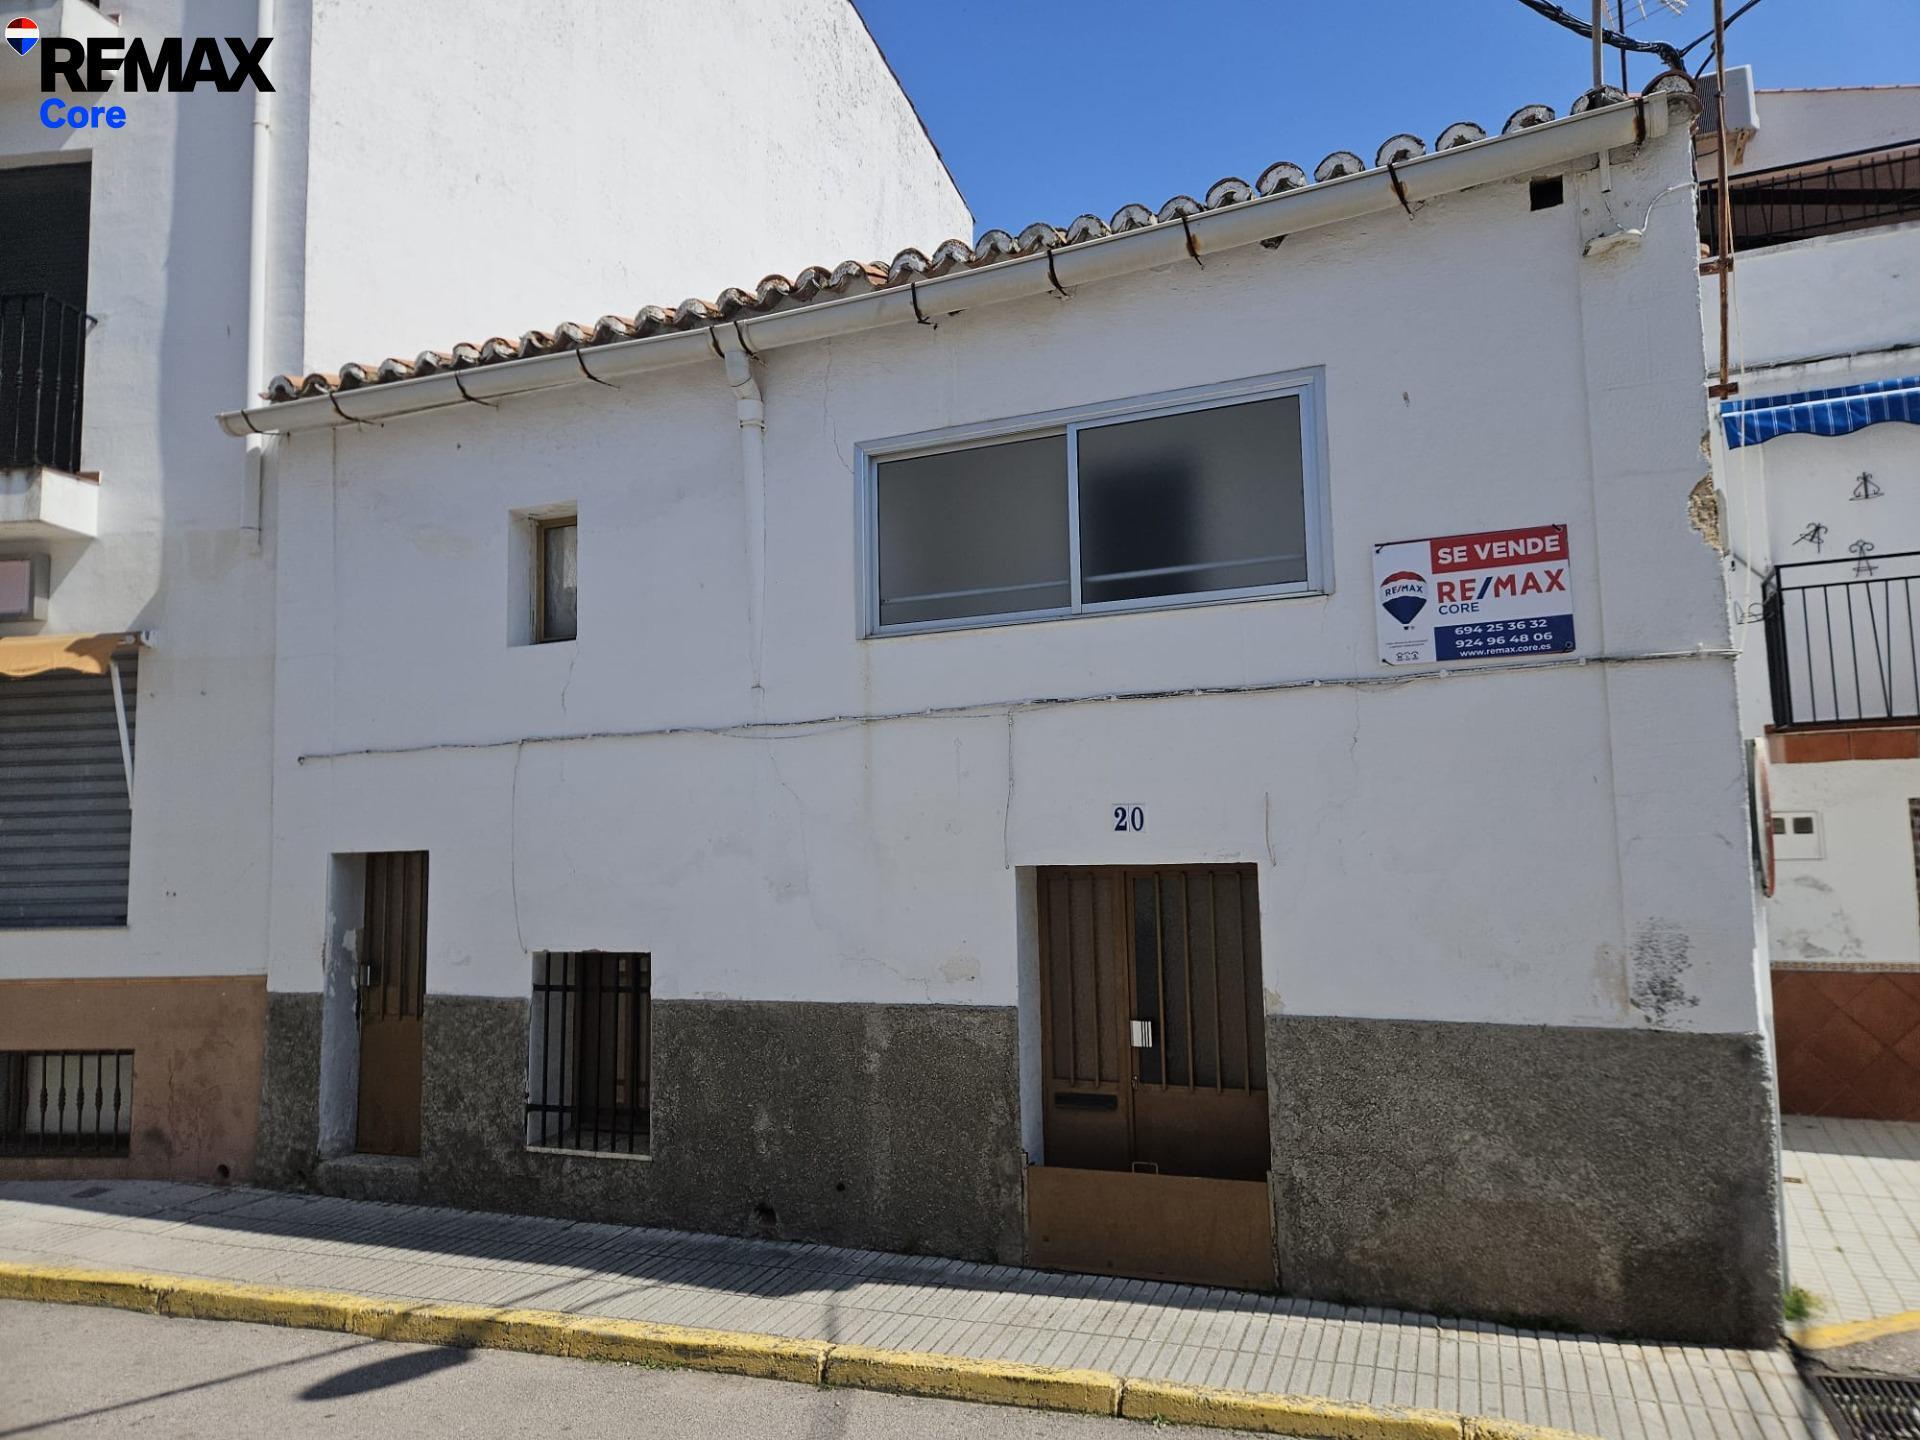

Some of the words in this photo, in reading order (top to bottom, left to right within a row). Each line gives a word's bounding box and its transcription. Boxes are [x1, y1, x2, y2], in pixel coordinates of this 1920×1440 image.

[1438, 546, 1468, 565] SE
[1474, 535, 1561, 561] VENDE
[1385, 583, 1424, 597] RE/MAX
[1436, 568, 1566, 604] RE/MAX
[1438, 602, 1480, 615] CORE
[1454, 625, 1483, 636] 694
[1486, 623, 1504, 633] 25
[1507, 621, 1526, 631] 36
[1529, 619, 1548, 629] 32
[1455, 638, 1484, 648] 924
[1486, 636, 1506, 646] 96
[1509, 634, 1529, 643] 48
[1533, 632, 1553, 641] 06
[1459, 643, 1552, 657] www.remax.core.es
[1114, 806, 1144, 831] 20
